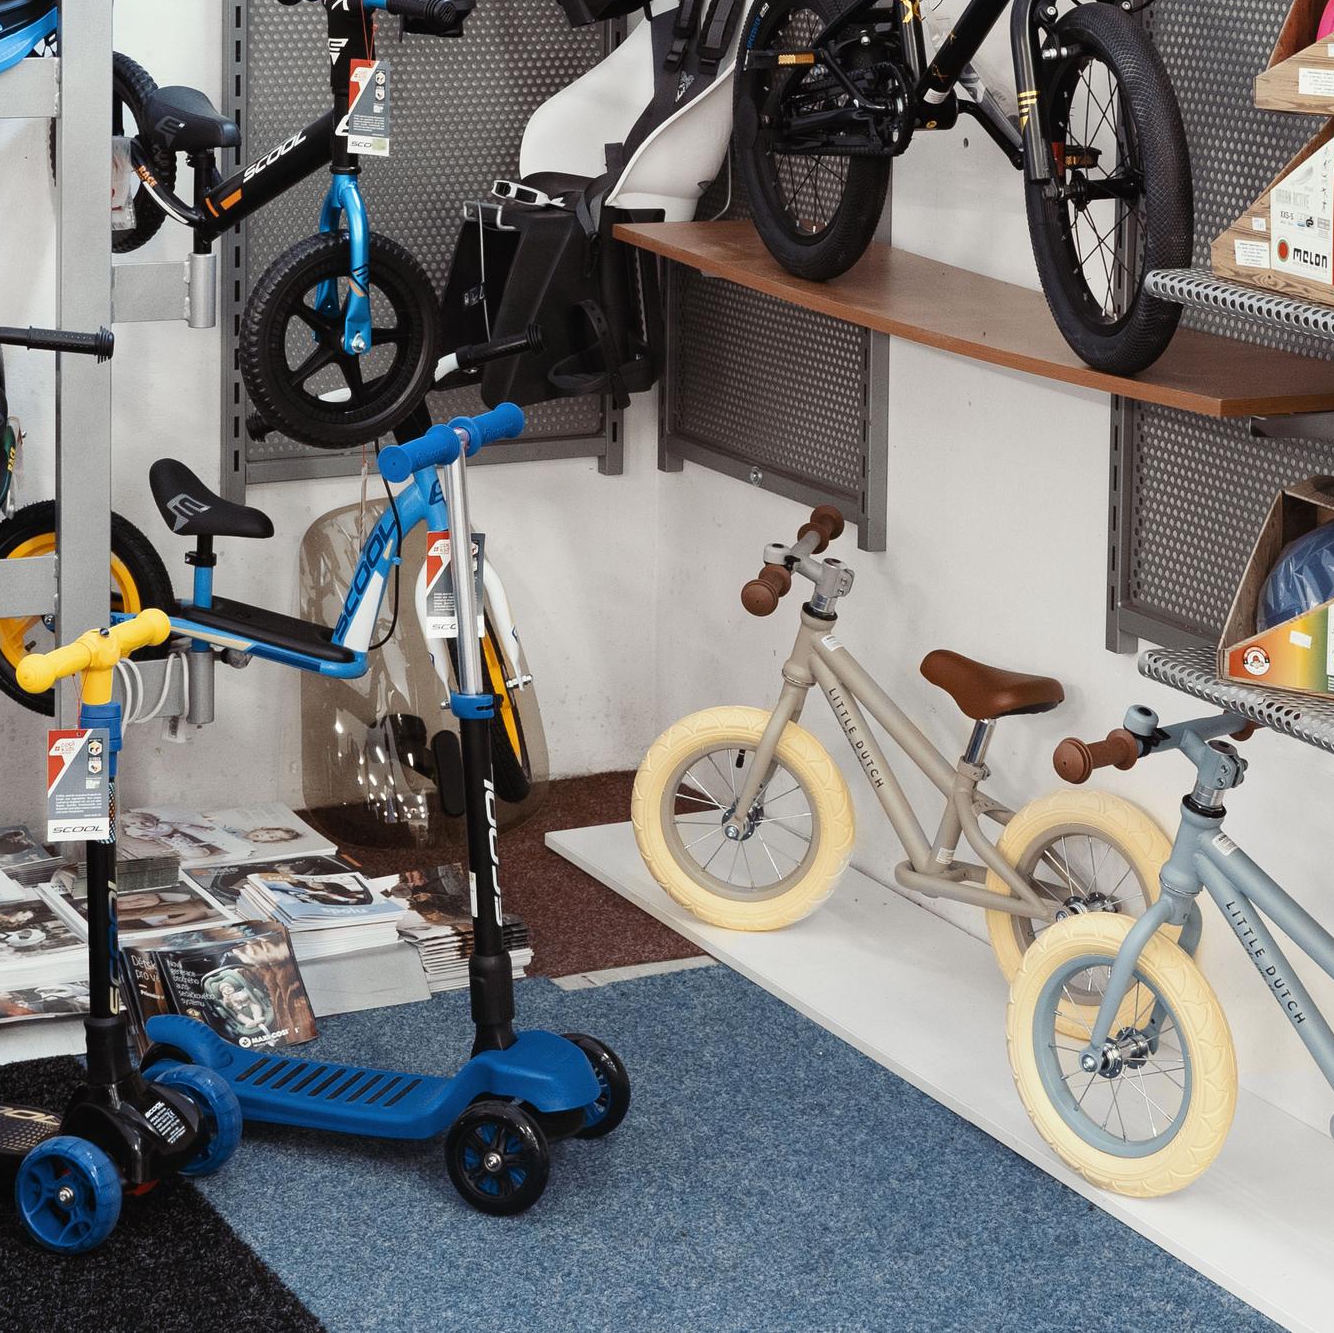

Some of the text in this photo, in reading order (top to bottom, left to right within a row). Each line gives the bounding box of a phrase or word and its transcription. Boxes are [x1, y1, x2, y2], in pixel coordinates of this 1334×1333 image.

[243, 130, 307, 183] SCOOL
[139, 164, 158, 188] RACE
[1292, 247, 1328, 269] MELON
[7, 445, 16, 472] RACE
[336, 519, 398, 642] SCOOL
[827, 687, 884, 790] LITTLE DUTCH
[52, 825, 104, 834] SCOOL
[131, 954, 157, 969] Dětsk
[1225, 900, 1306, 1024] LITTLE DUTCH
